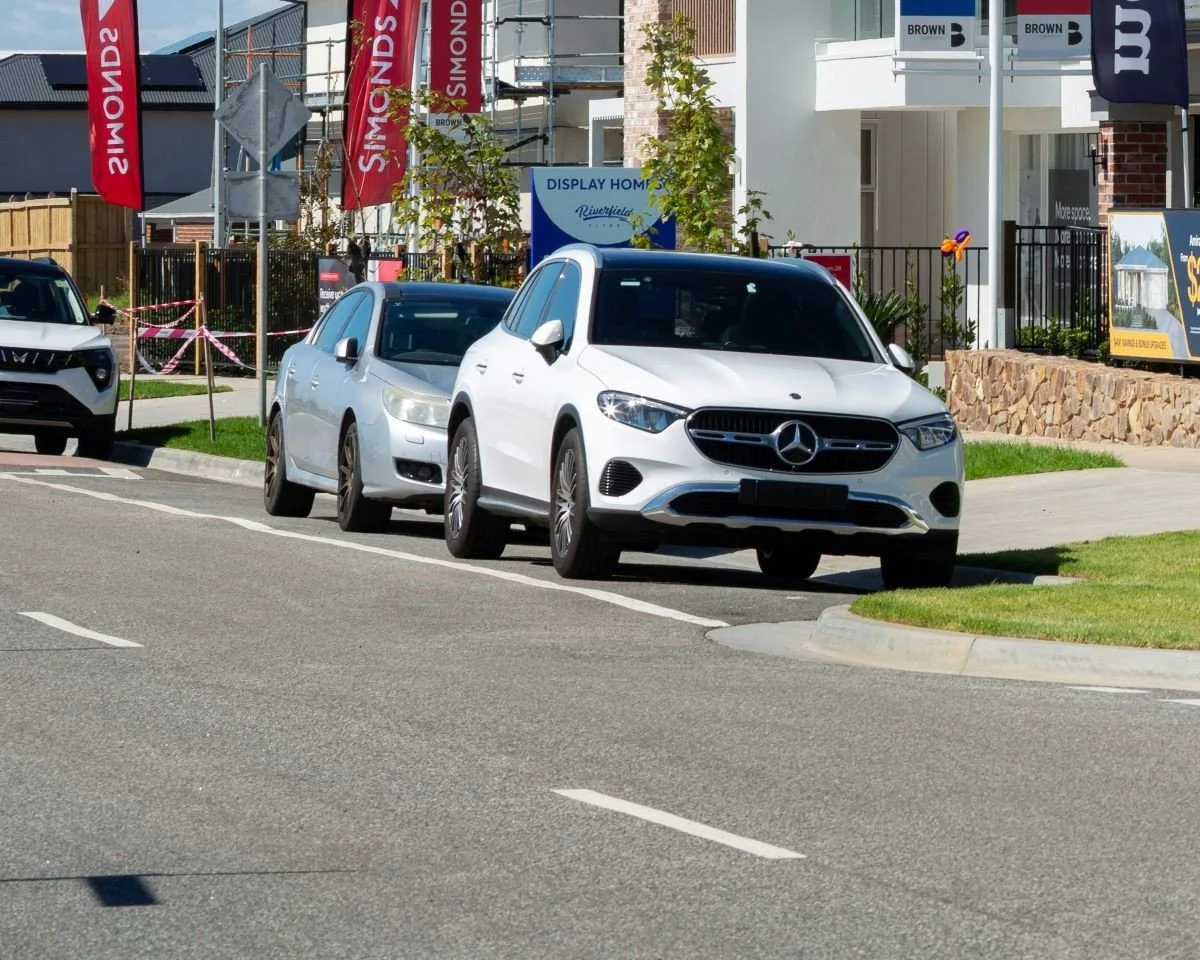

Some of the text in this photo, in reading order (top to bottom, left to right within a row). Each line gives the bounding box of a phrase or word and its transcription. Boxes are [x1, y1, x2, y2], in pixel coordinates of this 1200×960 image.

[907, 24, 946, 35] BROWN
[1024, 23, 1063, 34] BROWN
[357, 15, 398, 174] SIMONDS
[547, 178, 606, 191] DISPLAY
[576, 204, 634, 219] Riverfield
